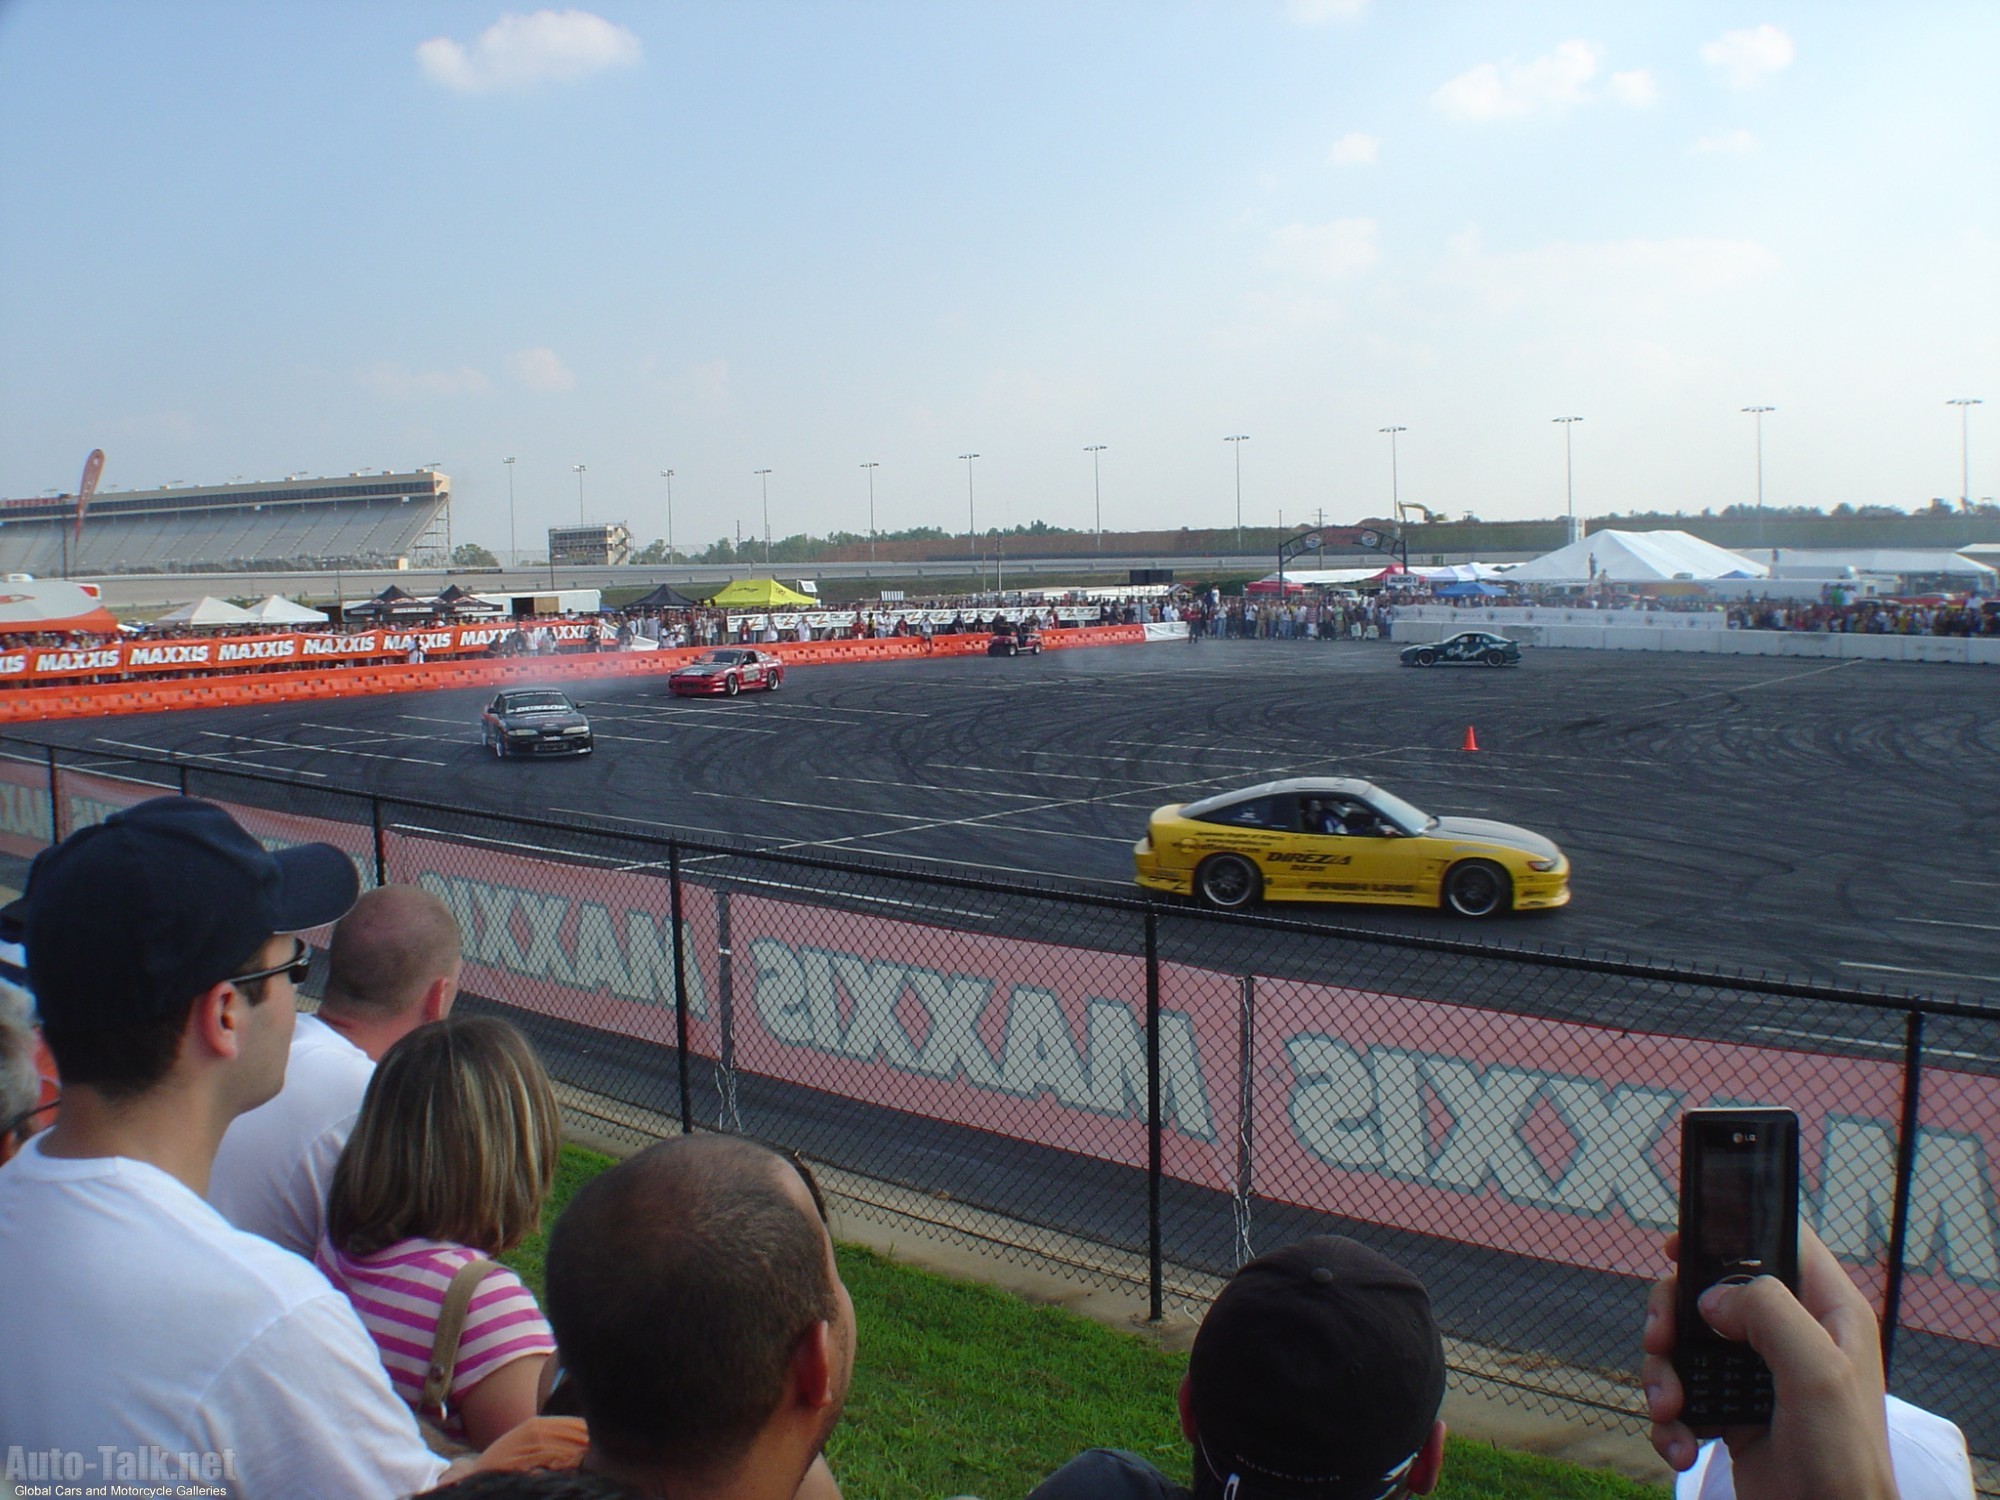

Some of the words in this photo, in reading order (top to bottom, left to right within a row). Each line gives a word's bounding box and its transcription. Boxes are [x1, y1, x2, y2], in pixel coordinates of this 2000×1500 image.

[130, 645, 209, 666] MAXXIS
[218, 640, 294, 661] MAXXIS
[303, 636, 375, 654] MAXXIS
[36, 650, 119, 672] MAXXIS
